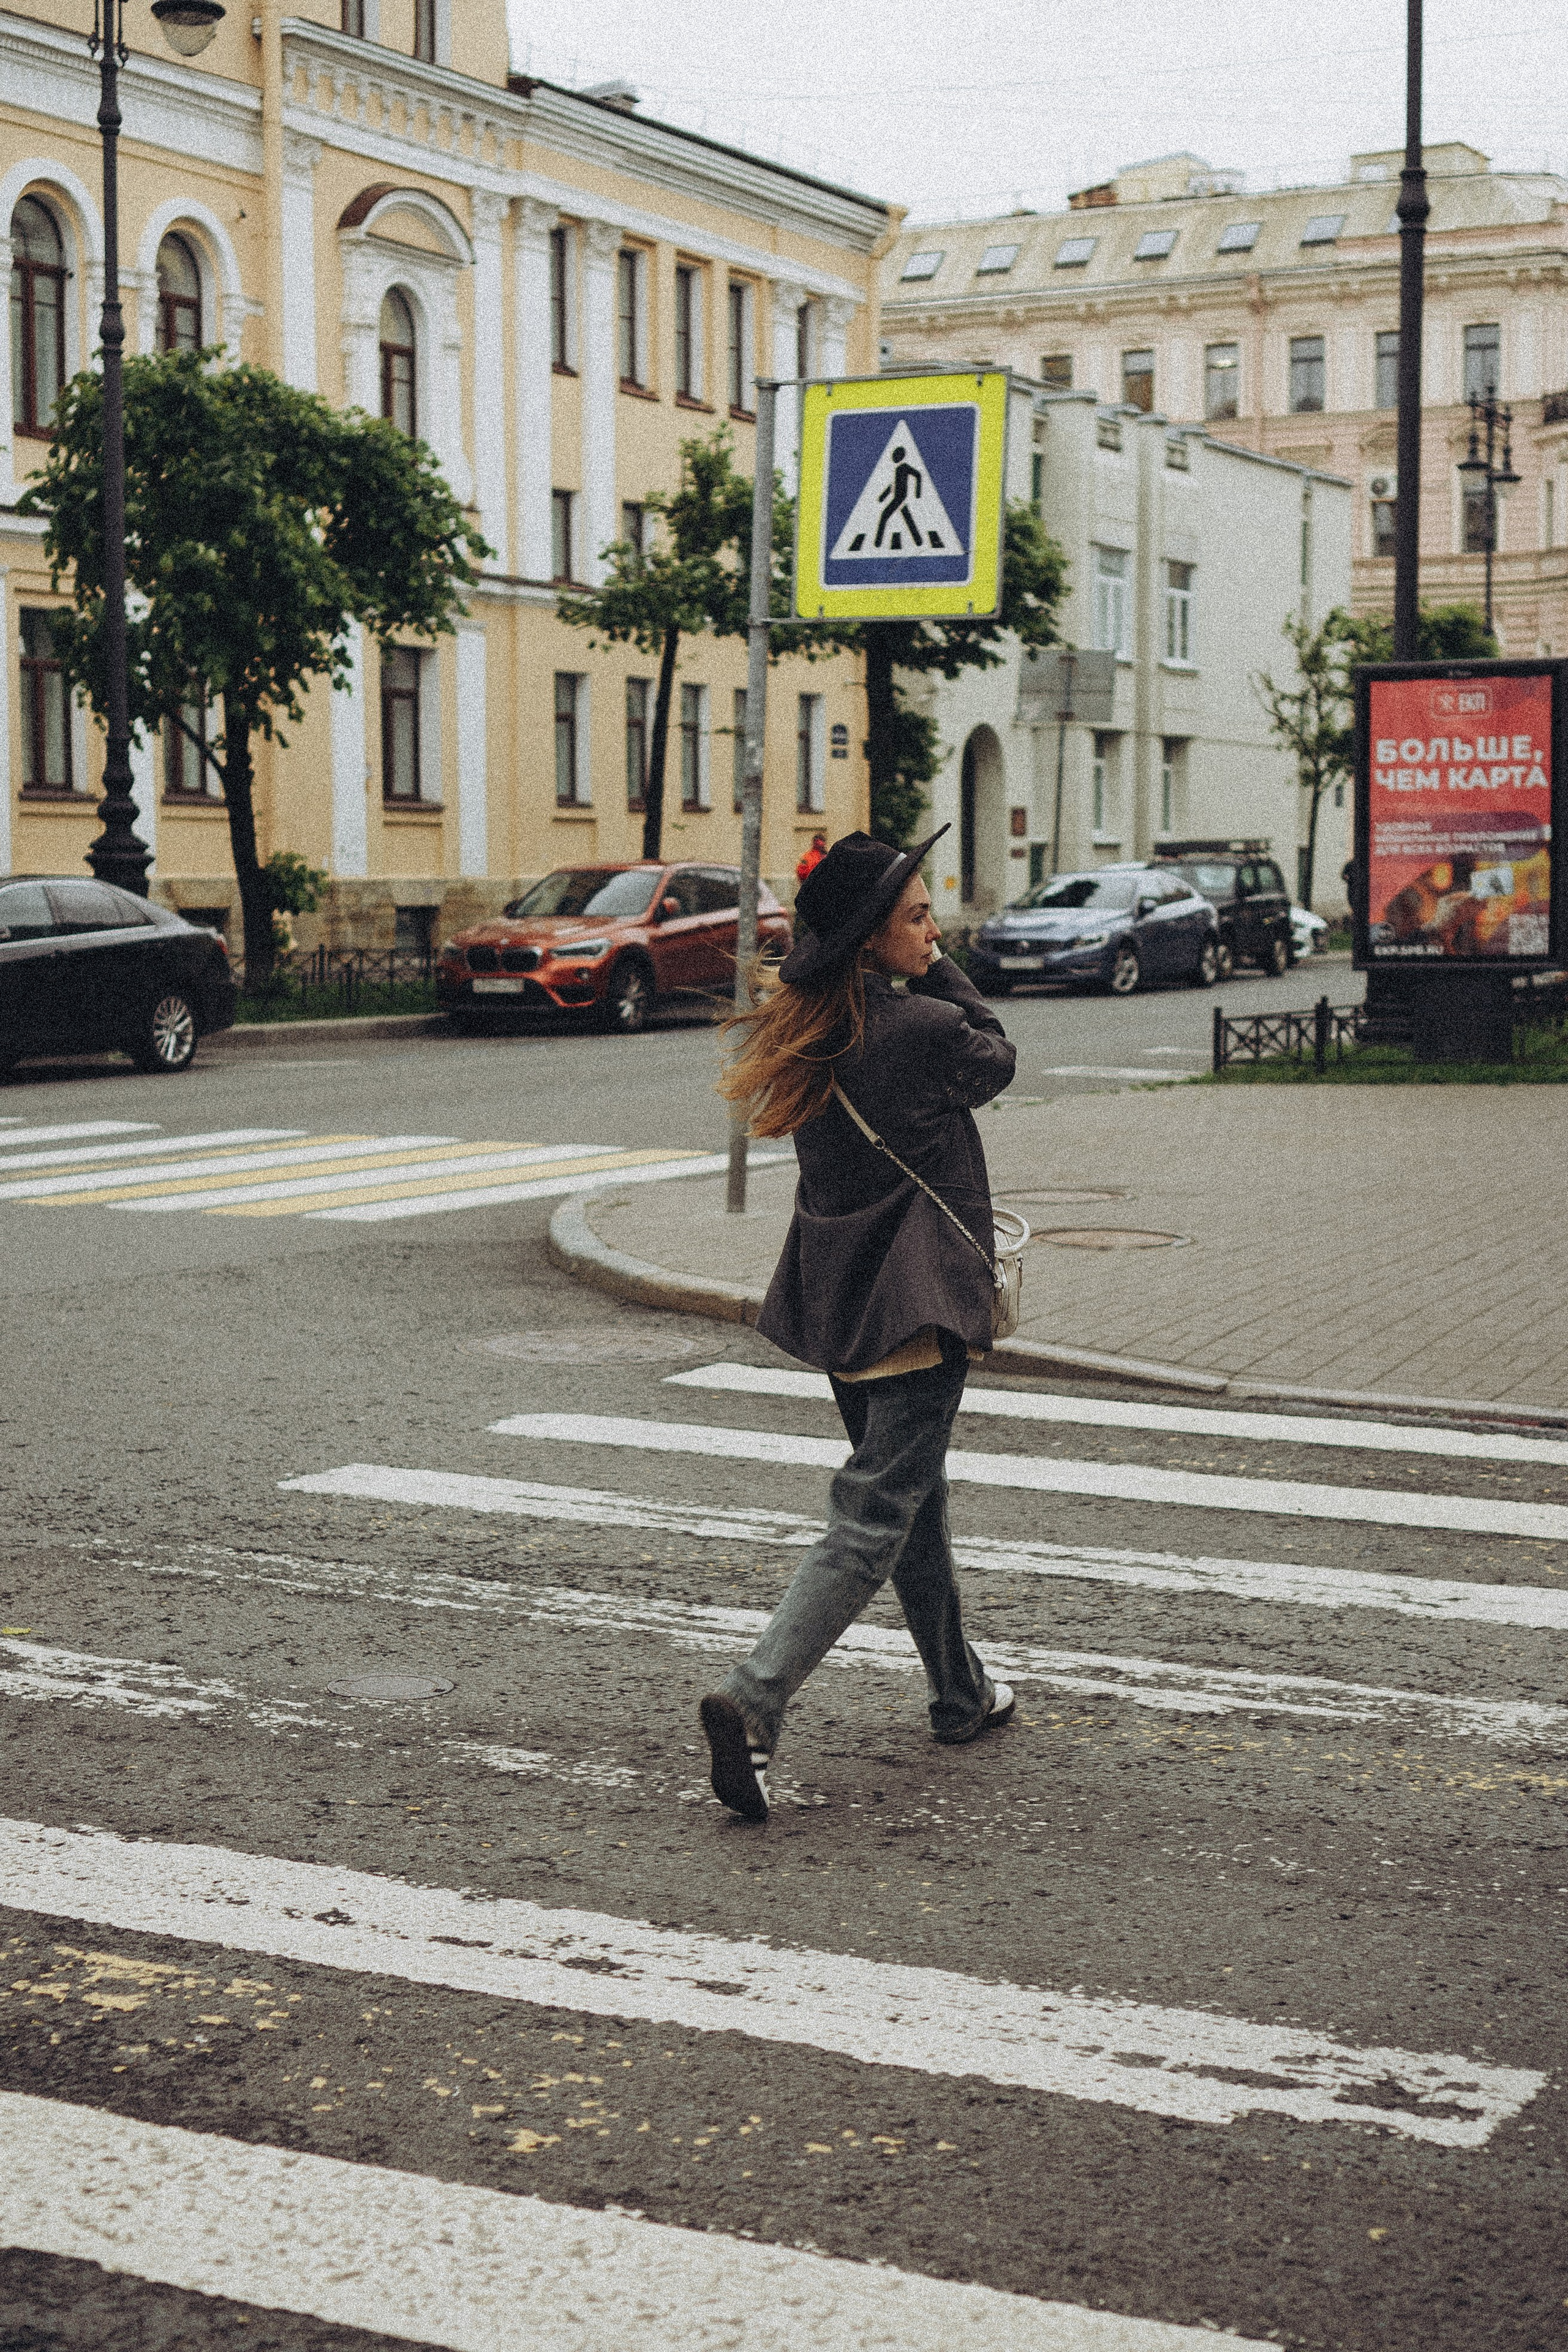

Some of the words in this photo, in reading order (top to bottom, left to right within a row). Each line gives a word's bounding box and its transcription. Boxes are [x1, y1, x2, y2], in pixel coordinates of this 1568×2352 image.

[1376, 734, 1543, 763] БОЛЬШЕ,
[1374, 767, 1439, 790] ЧЕМ
[1447, 765, 1548, 790] КАРТА
